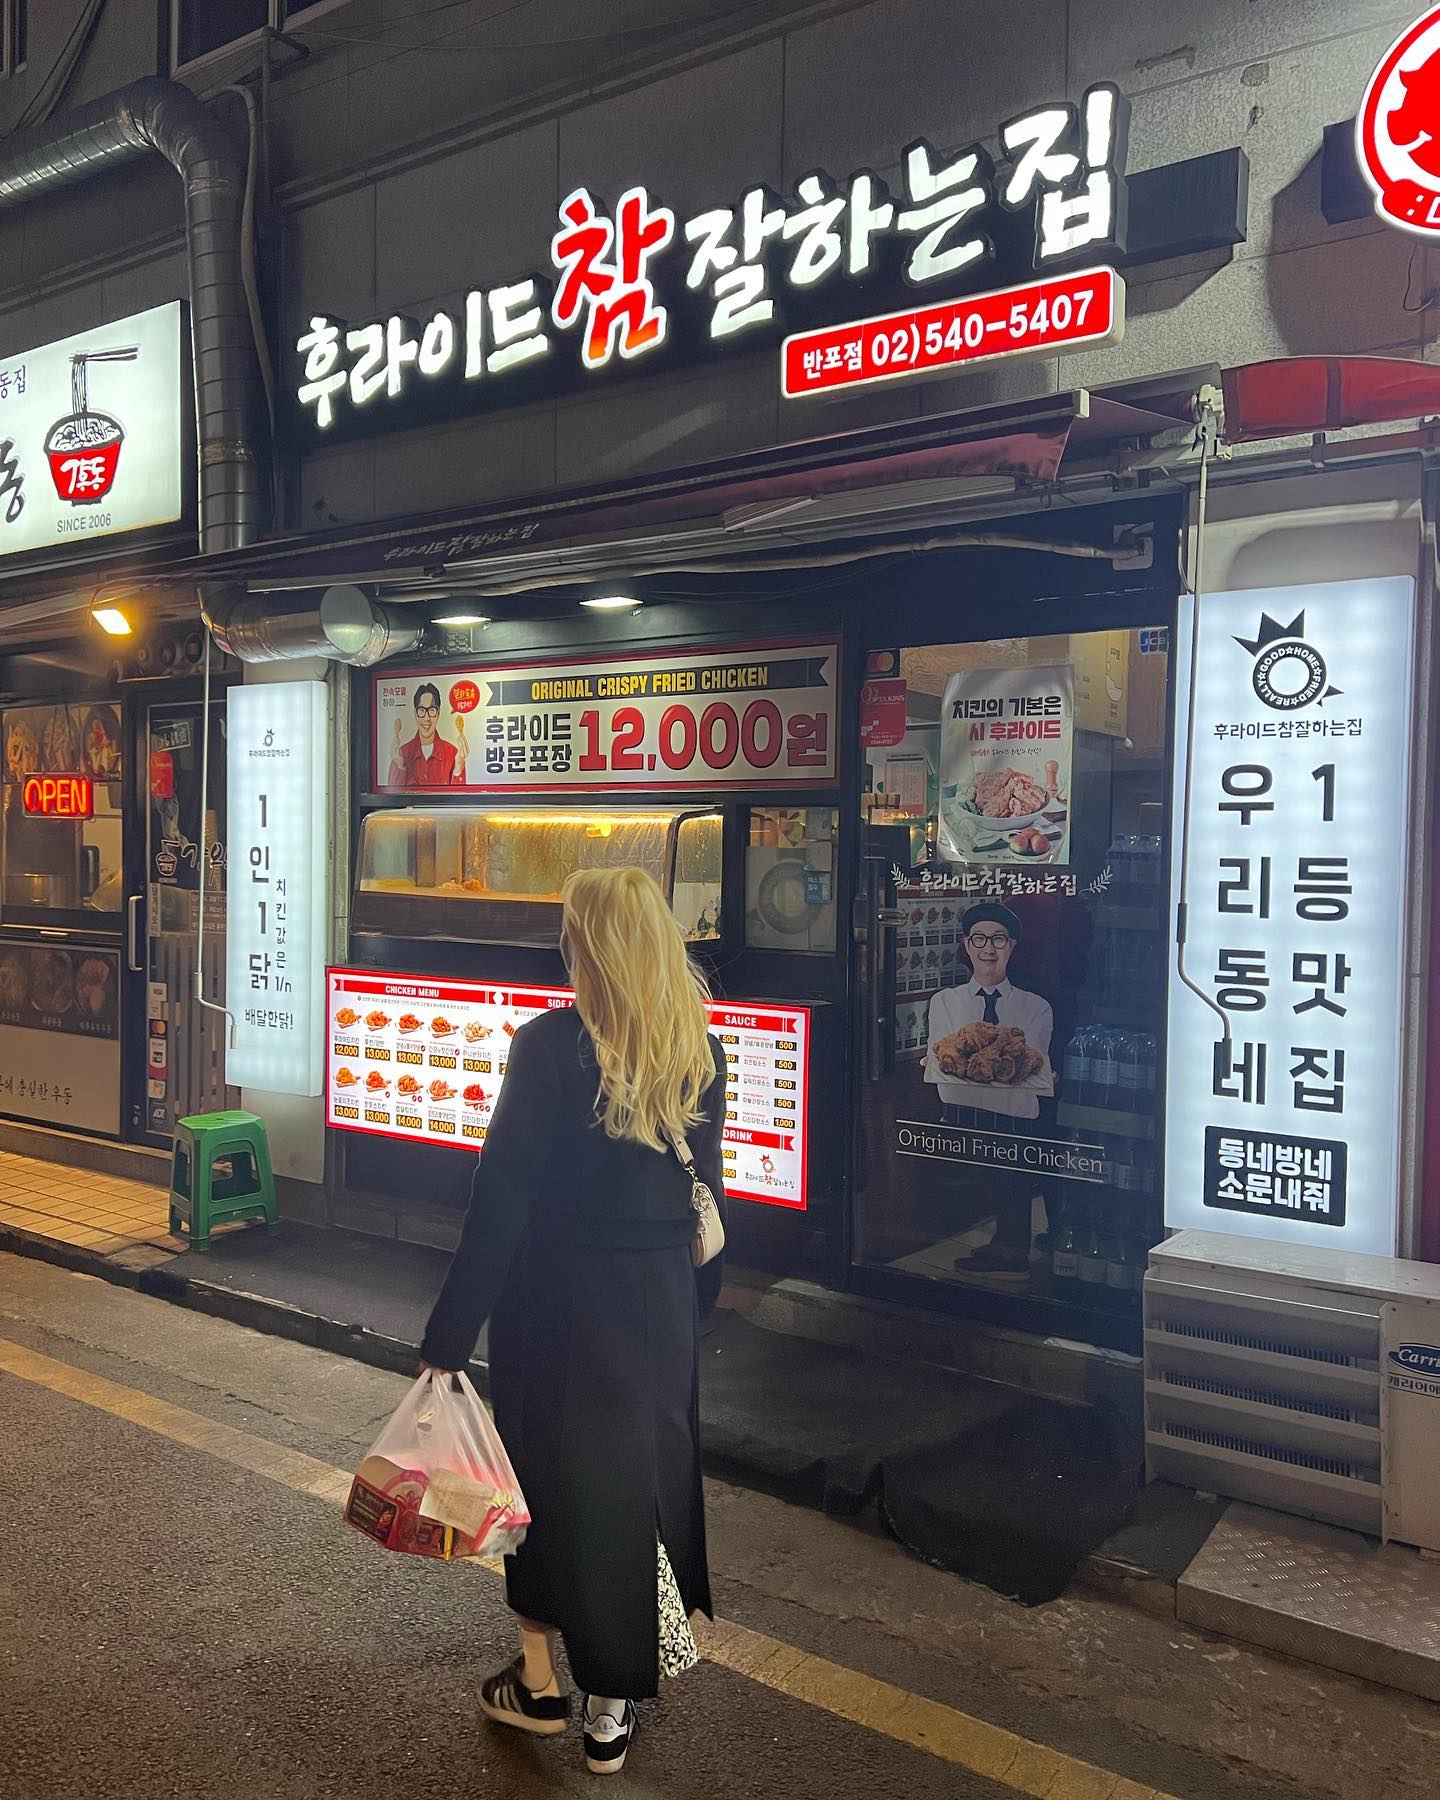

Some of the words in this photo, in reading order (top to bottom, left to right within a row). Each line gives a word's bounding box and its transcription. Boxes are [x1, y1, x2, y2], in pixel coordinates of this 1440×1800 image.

[802, 344, 863, 381] 반포점
[57, 517, 87, 533] SINCE
[89, 513, 112, 529] 2006
[1260, 648, 1286, 672] GOOD
[1293, 646, 1320, 669] HOME
[531, 679, 594, 702] ORIGINAL
[597, 674, 650, 697] CRISPY
[652, 671, 697, 694] FRIED
[700, 666, 769, 691] CHICKEN
[1298, 675, 1322, 702] FRIED
[1257, 680, 1290, 706] REALLY
[952, 698, 1004, 719] 치킨의
[1008, 695, 1062, 717] 기본은
[486, 712, 572, 744] 후라이드
[990, 719, 1061, 741] 후라이드
[1213, 716, 1364, 740] 후라이드참잘하는집
[485, 746, 573, 774] 방문포장
[24, 778, 87, 815] OPEN
[385, 985, 416, 996] CHICKEN
[418, 987, 440, 998] MENU
[547, 998, 566, 1009] SIDE
[244, 1008, 294, 1030] 배달한닭!
[724, 1014, 757, 1027] SAUCE
[722, 1035, 736, 1044] 500
[778, 1041, 794, 1050] 500
[335, 1044, 358, 1056] 12,000
[366, 1048, 390, 1060] 13,000
[397, 1051, 422, 1064] 13,000
[430, 1055, 456, 1068] 13,000
[463, 1060, 490, 1072] 13,000
[778, 1061, 793, 1070] 500
[18, 1078, 49, 1101] 충실한
[52, 1085, 73, 1105] 우동
[777, 1080, 793, 1089] 500
[777, 1099, 792, 1108] 500
[335, 1106, 358, 1118] 13,000
[365, 1110, 389, 1123] 13,000
[397, 1115, 421, 1128] 14,000
[429, 1120, 455, 1133] 14,000
[723, 1129, 752, 1142] DRINK
[897, 1128, 967, 1155] Original
[972, 1138, 1019, 1162] Fried
[1022, 1145, 1103, 1174] Chicken
[1217, 1136, 1332, 1182] 동네방네
[1217, 1167, 1331, 1215] 소문내줘
